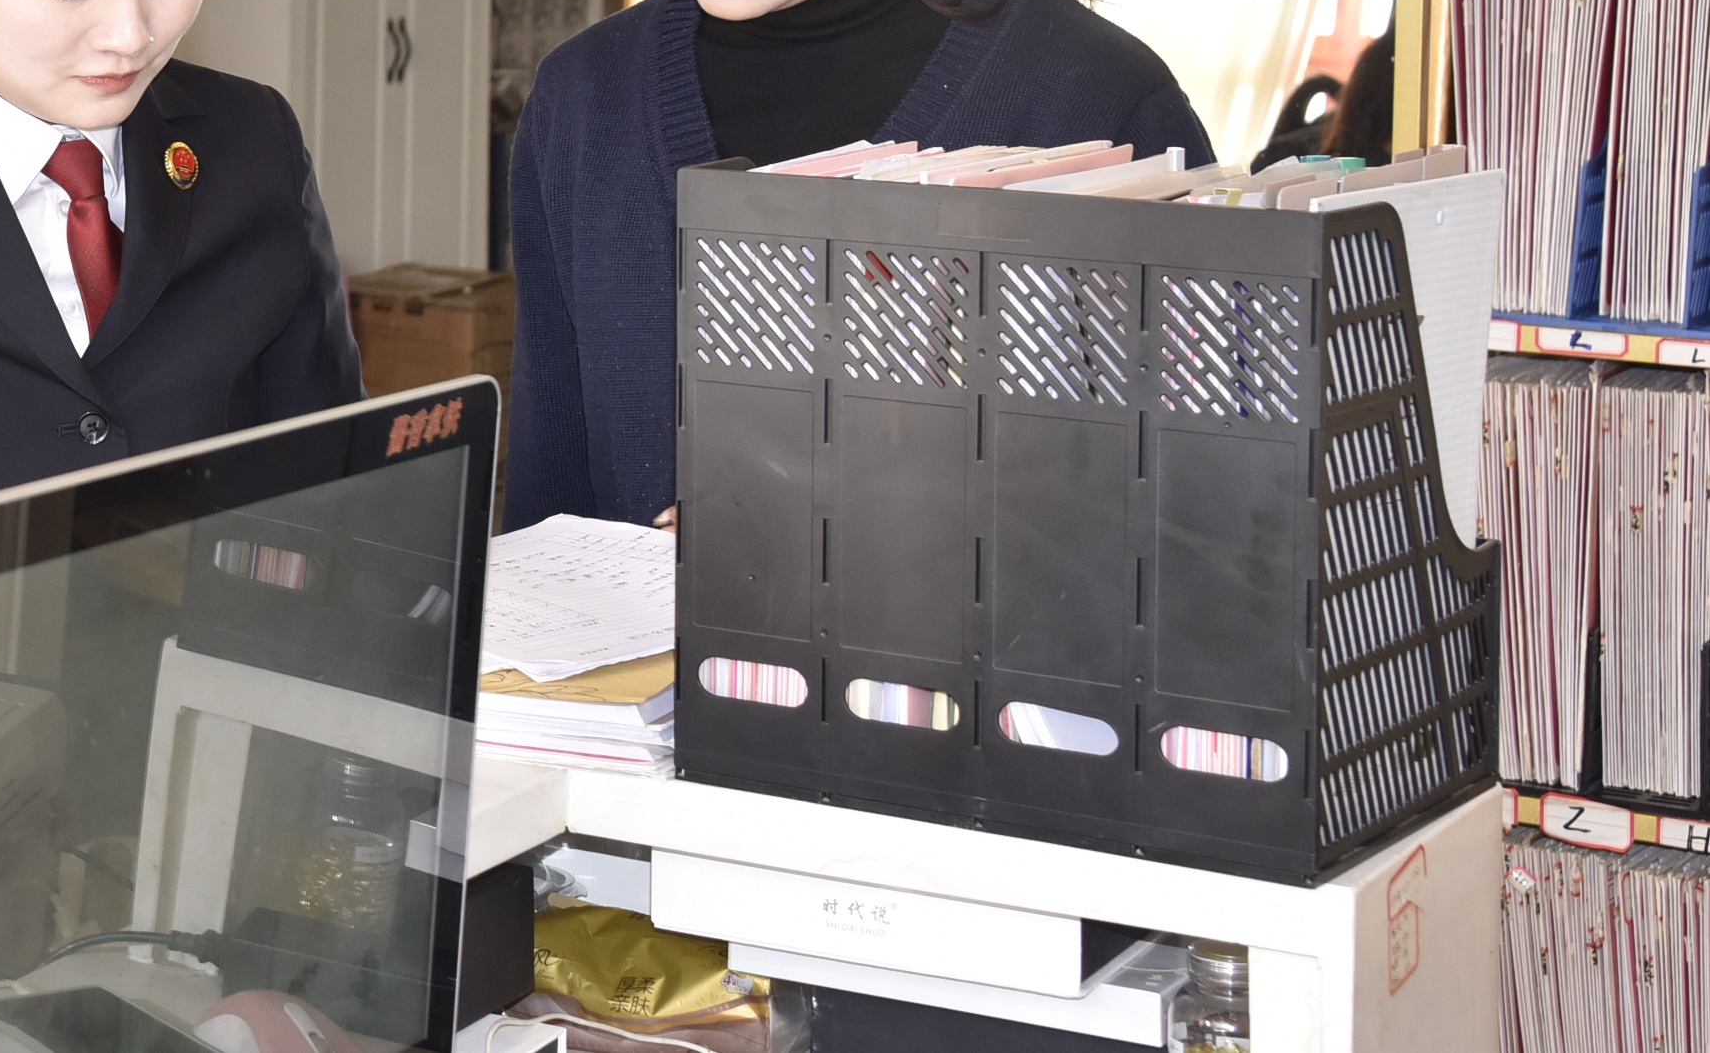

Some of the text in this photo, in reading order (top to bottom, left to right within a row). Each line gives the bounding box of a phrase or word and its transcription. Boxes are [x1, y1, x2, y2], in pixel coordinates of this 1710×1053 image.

[822, 897, 891, 925] 时代说
[615, 977, 656, 995] 厚柔
[609, 995, 651, 1017] 亲肤
